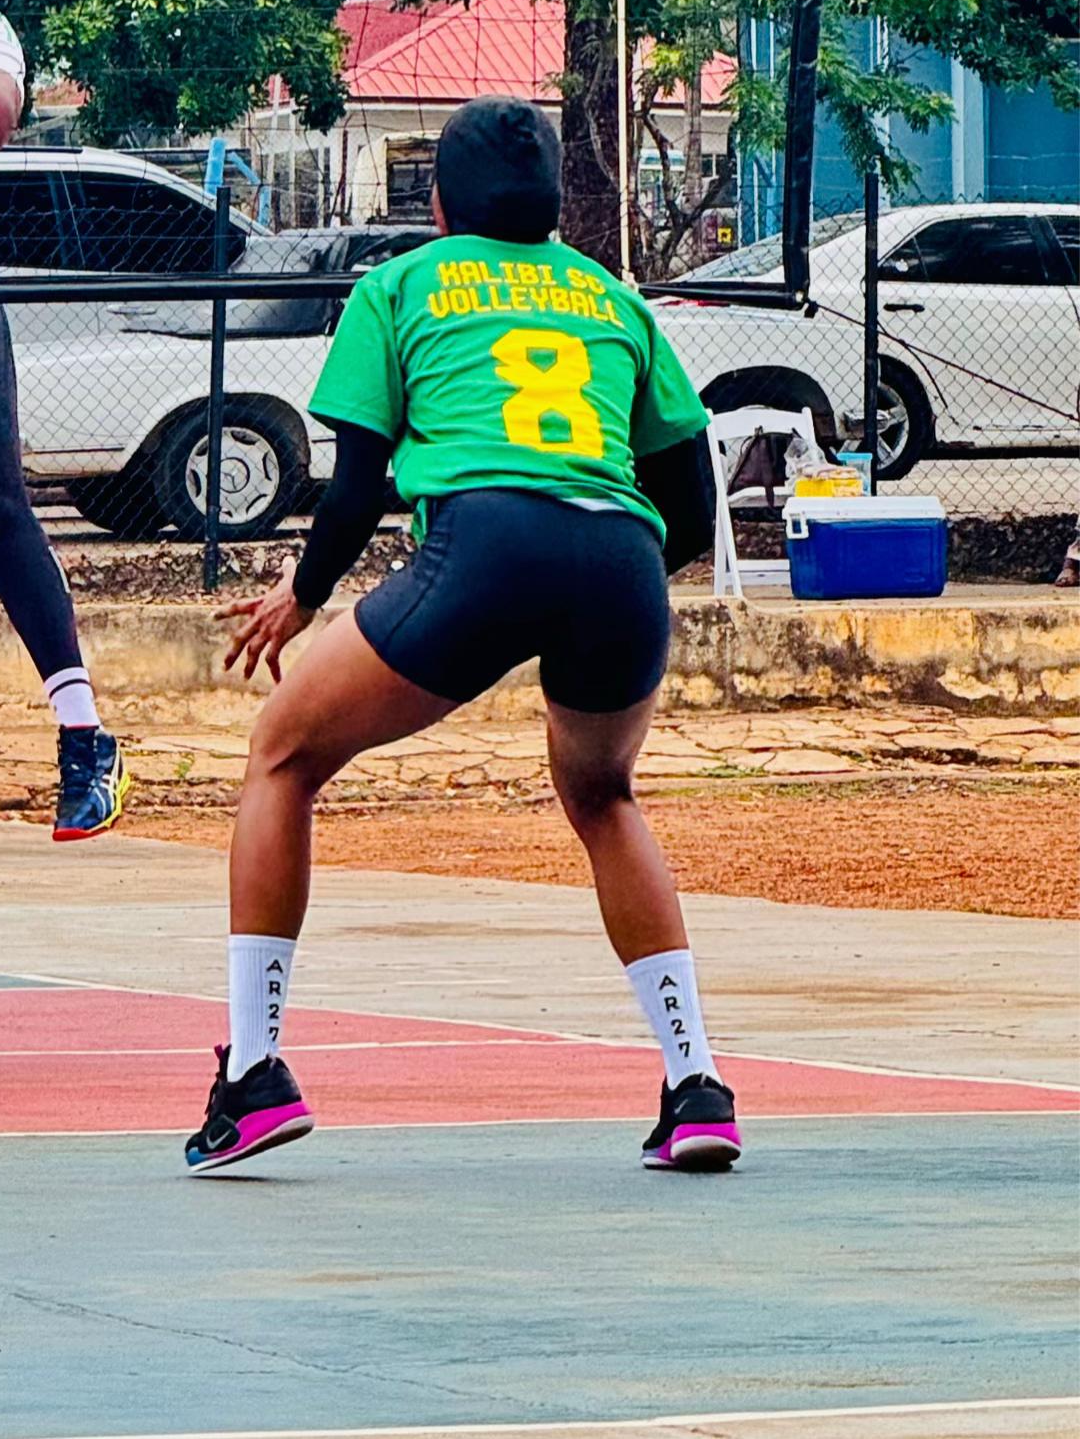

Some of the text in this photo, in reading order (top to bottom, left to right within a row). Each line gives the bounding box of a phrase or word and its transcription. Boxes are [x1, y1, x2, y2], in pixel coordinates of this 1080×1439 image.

[428, 284, 625, 329] VOLLEYBALL
[438, 261, 607, 295] KALIBI SC
[491, 328, 605, 459] 8
[266, 959, 284, 1042] AR27
[659, 974, 691, 1058] AR27
